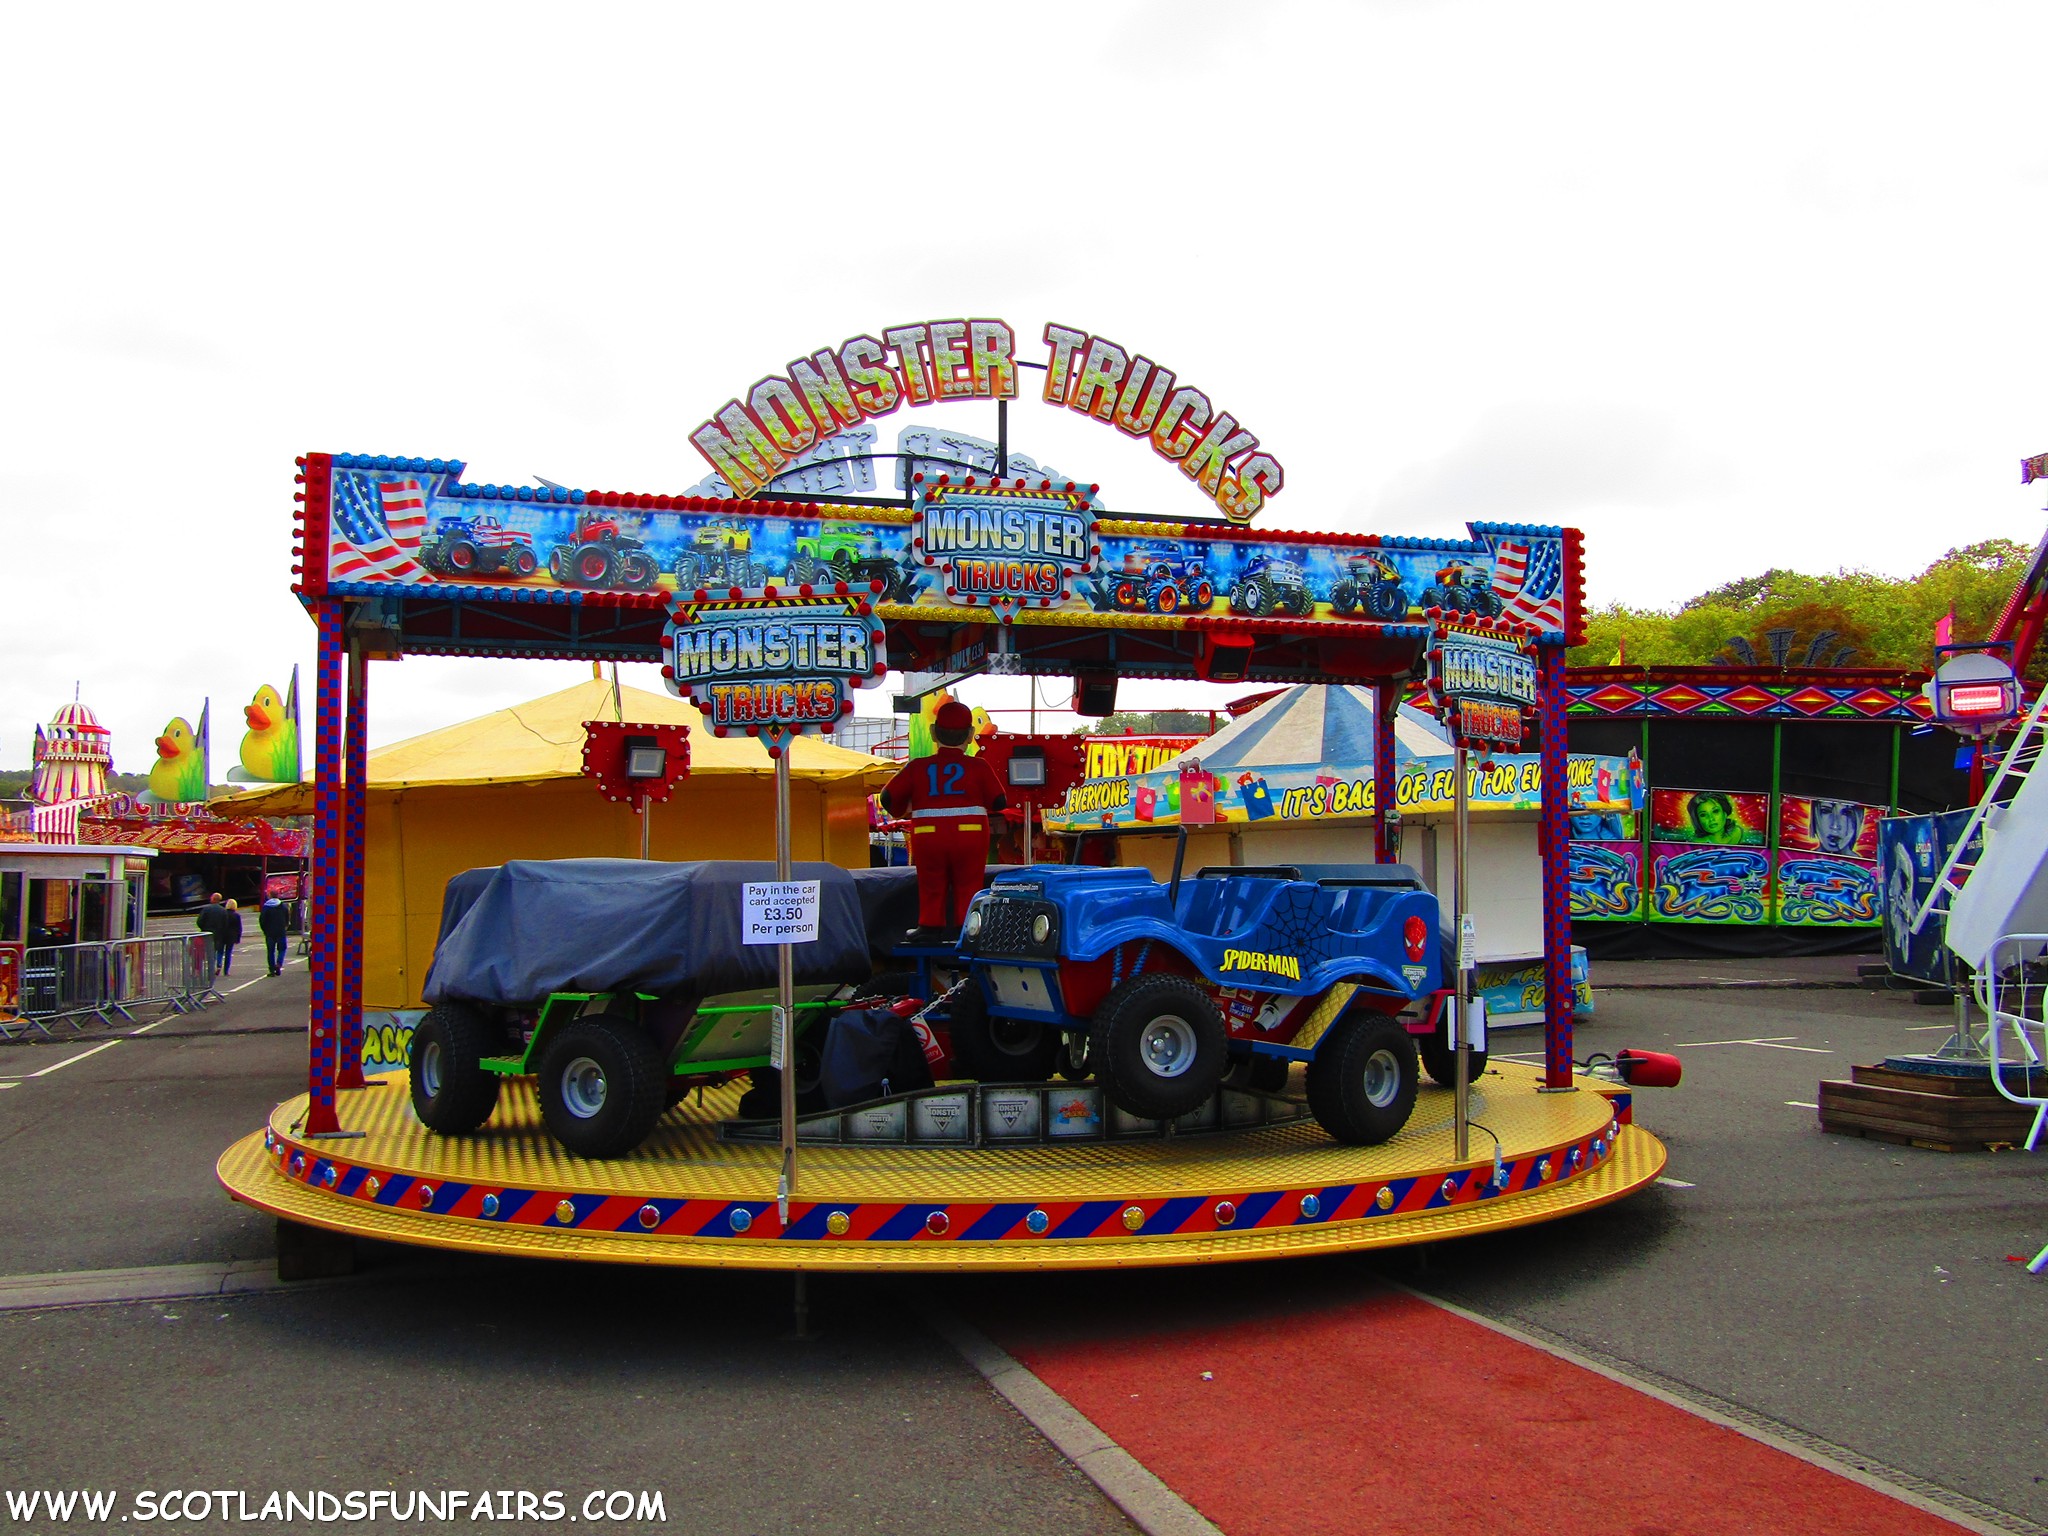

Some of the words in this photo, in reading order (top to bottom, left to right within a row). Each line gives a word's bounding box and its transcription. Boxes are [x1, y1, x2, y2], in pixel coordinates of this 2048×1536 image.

[689, 319, 1019, 498] MONSTER
[1043, 322, 1283, 523] TRUCKS
[927, 508, 1086, 559] MONSTER
[956, 558, 1057, 594] TRUCKS
[677, 624, 868, 679] MONSTER
[1444, 649, 1537, 701] MONSTER
[711, 681, 836, 722] TRUCKS
[1460, 700, 1521, 741] TRUCKS
[926, 762, 966, 796] 12
[1068, 778, 1130, 815] EVERYONE
[1281, 784, 1327, 819] IT'S
[1332, 778, 1375, 813] BAG
[1397, 773, 1427, 804] OF
[1481, 763, 1516, 797] FOR
[1520, 757, 1596, 793] EVONE
[749, 886, 767, 897] Pay
[770, 886, 780, 895] in
[783, 886, 799, 894] the
[802, 885, 816, 894] car
[749, 897, 771, 906] card
[773, 896, 815, 906] accepted
[752, 923, 772, 934] Per
[776, 923, 813, 936] person
[764, 907, 803, 921] £3.50
[1219, 948, 1301, 982] SPIDER-MAN
[361, 1025, 415, 1068] ACK
